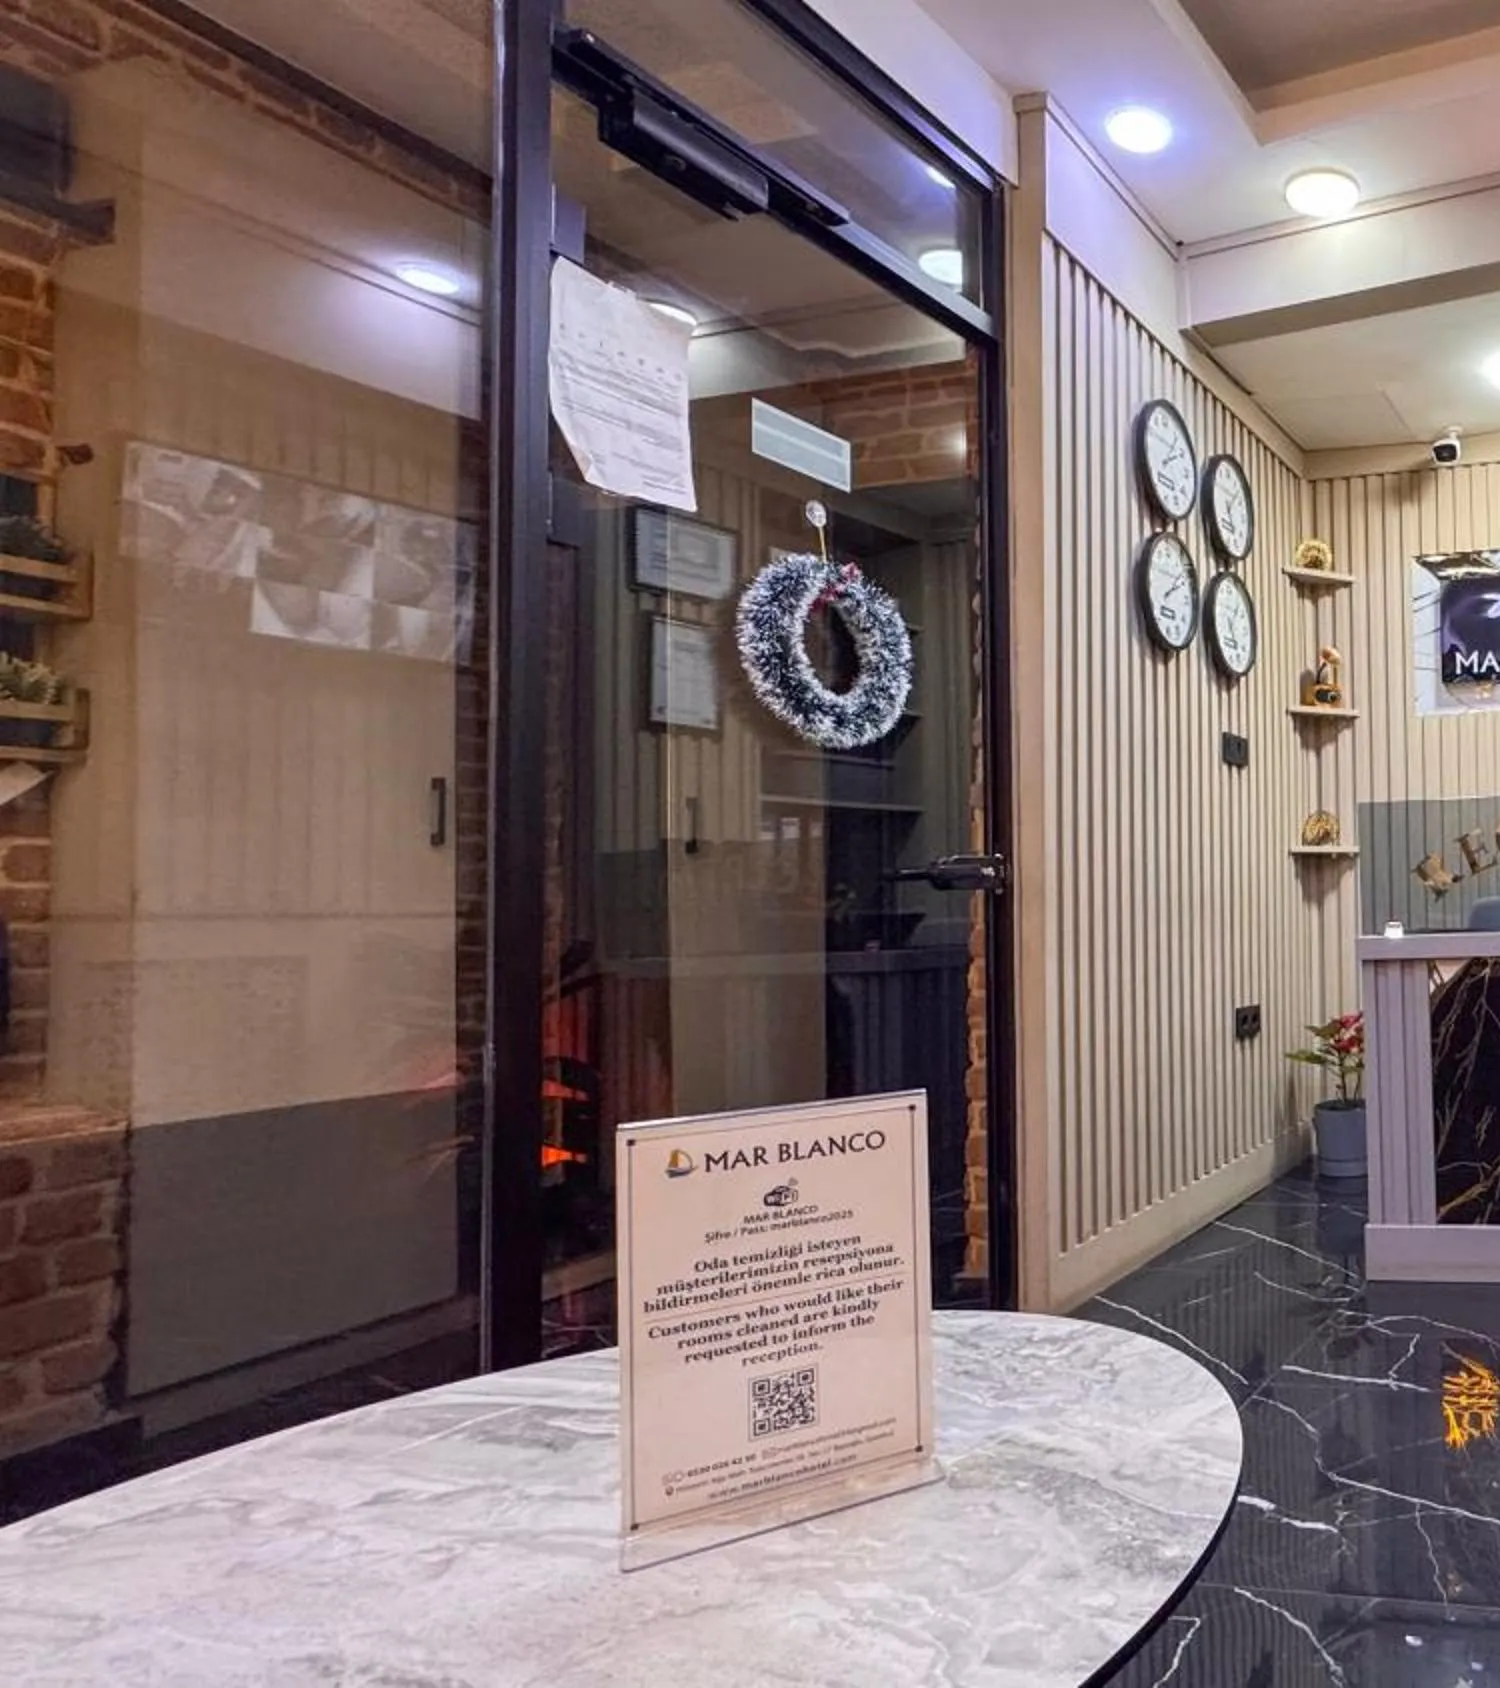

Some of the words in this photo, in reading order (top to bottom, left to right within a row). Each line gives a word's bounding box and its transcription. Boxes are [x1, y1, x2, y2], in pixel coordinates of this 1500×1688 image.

[704, 1145, 769, 1173] MAR
[777, 1129, 886, 1163] BLANCO
[740, 1223, 768, 1237] Pass:
[743, 1209, 770, 1225] MAR
[772, 1204, 819, 1221] BLANCO
[656, 1259, 799, 1297] müşterilerimizin
[803, 1243, 894, 1268] resepsiyona
[694, 1257, 729, 1274] Oda
[807, 1234, 862, 1253] isteyen
[642, 1281, 749, 1314] bildirmeleri
[751, 1271, 811, 1293] önemle
[815, 1265, 846, 1281] rica
[848, 1257, 905, 1274] olunur.
[647, 1312, 741, 1339] Customers
[744, 1303, 781, 1320] who
[784, 1292, 833, 1311] would
[835, 1284, 864, 1302] like
[867, 1278, 905, 1296] their
[677, 1330, 733, 1350] rooms
[736, 1312, 799, 1338] cleaned
[803, 1308, 829, 1323] are
[832, 1299, 879, 1318] kindly
[684, 1335, 767, 1365] requested
[771, 1330, 788, 1345] to
[792, 1320, 847, 1340] inform
[850, 1312, 876, 1328] the
[741, 1341, 824, 1368] reception.
